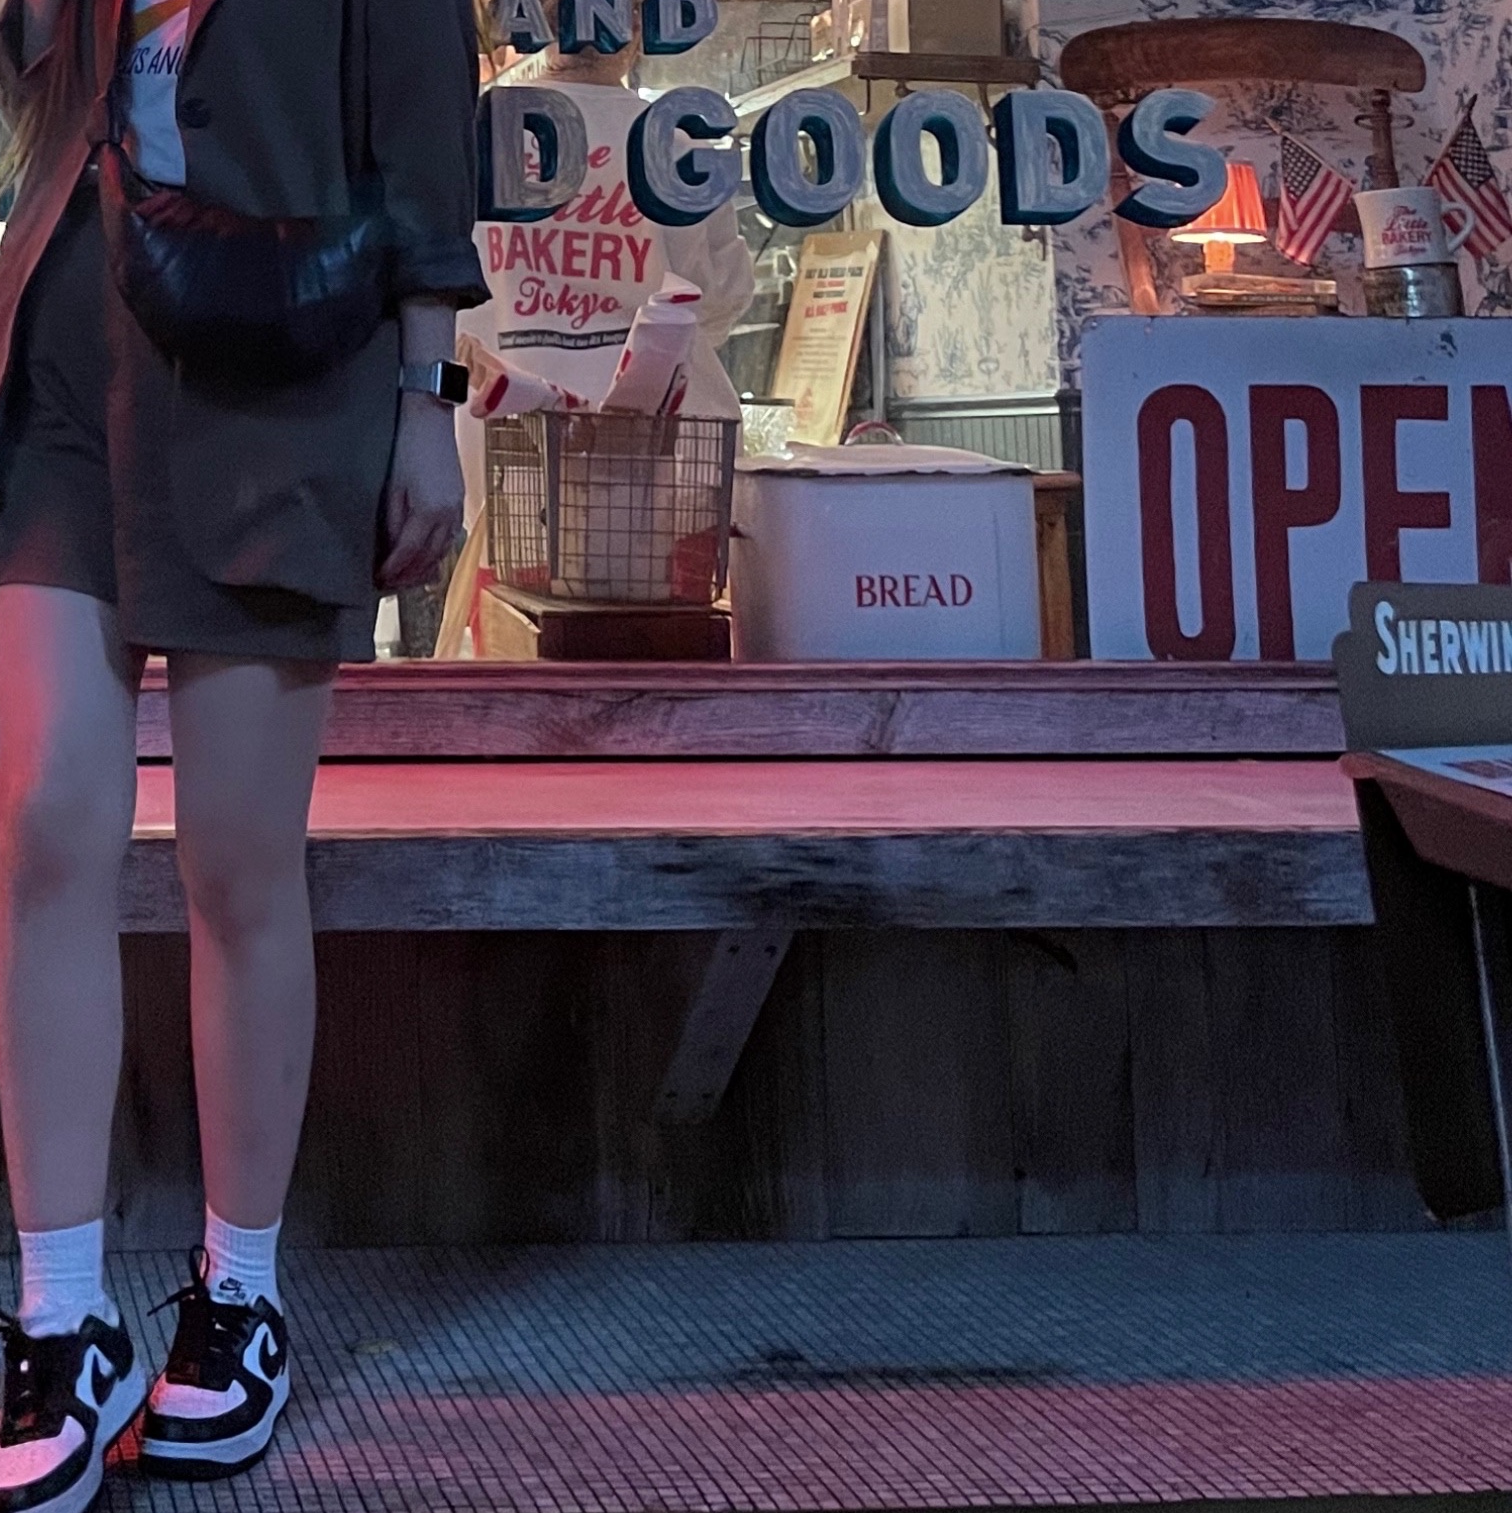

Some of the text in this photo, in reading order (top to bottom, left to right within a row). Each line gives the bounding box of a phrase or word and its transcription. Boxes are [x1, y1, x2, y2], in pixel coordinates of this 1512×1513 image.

[626, 87, 1228, 229] GOODS
[487, 224, 652, 284] BAKERY
[1381, 230, 1432, 245] BAKERY
[513, 276, 623, 330] Tokyo
[855, 573, 974, 608] BREAD
